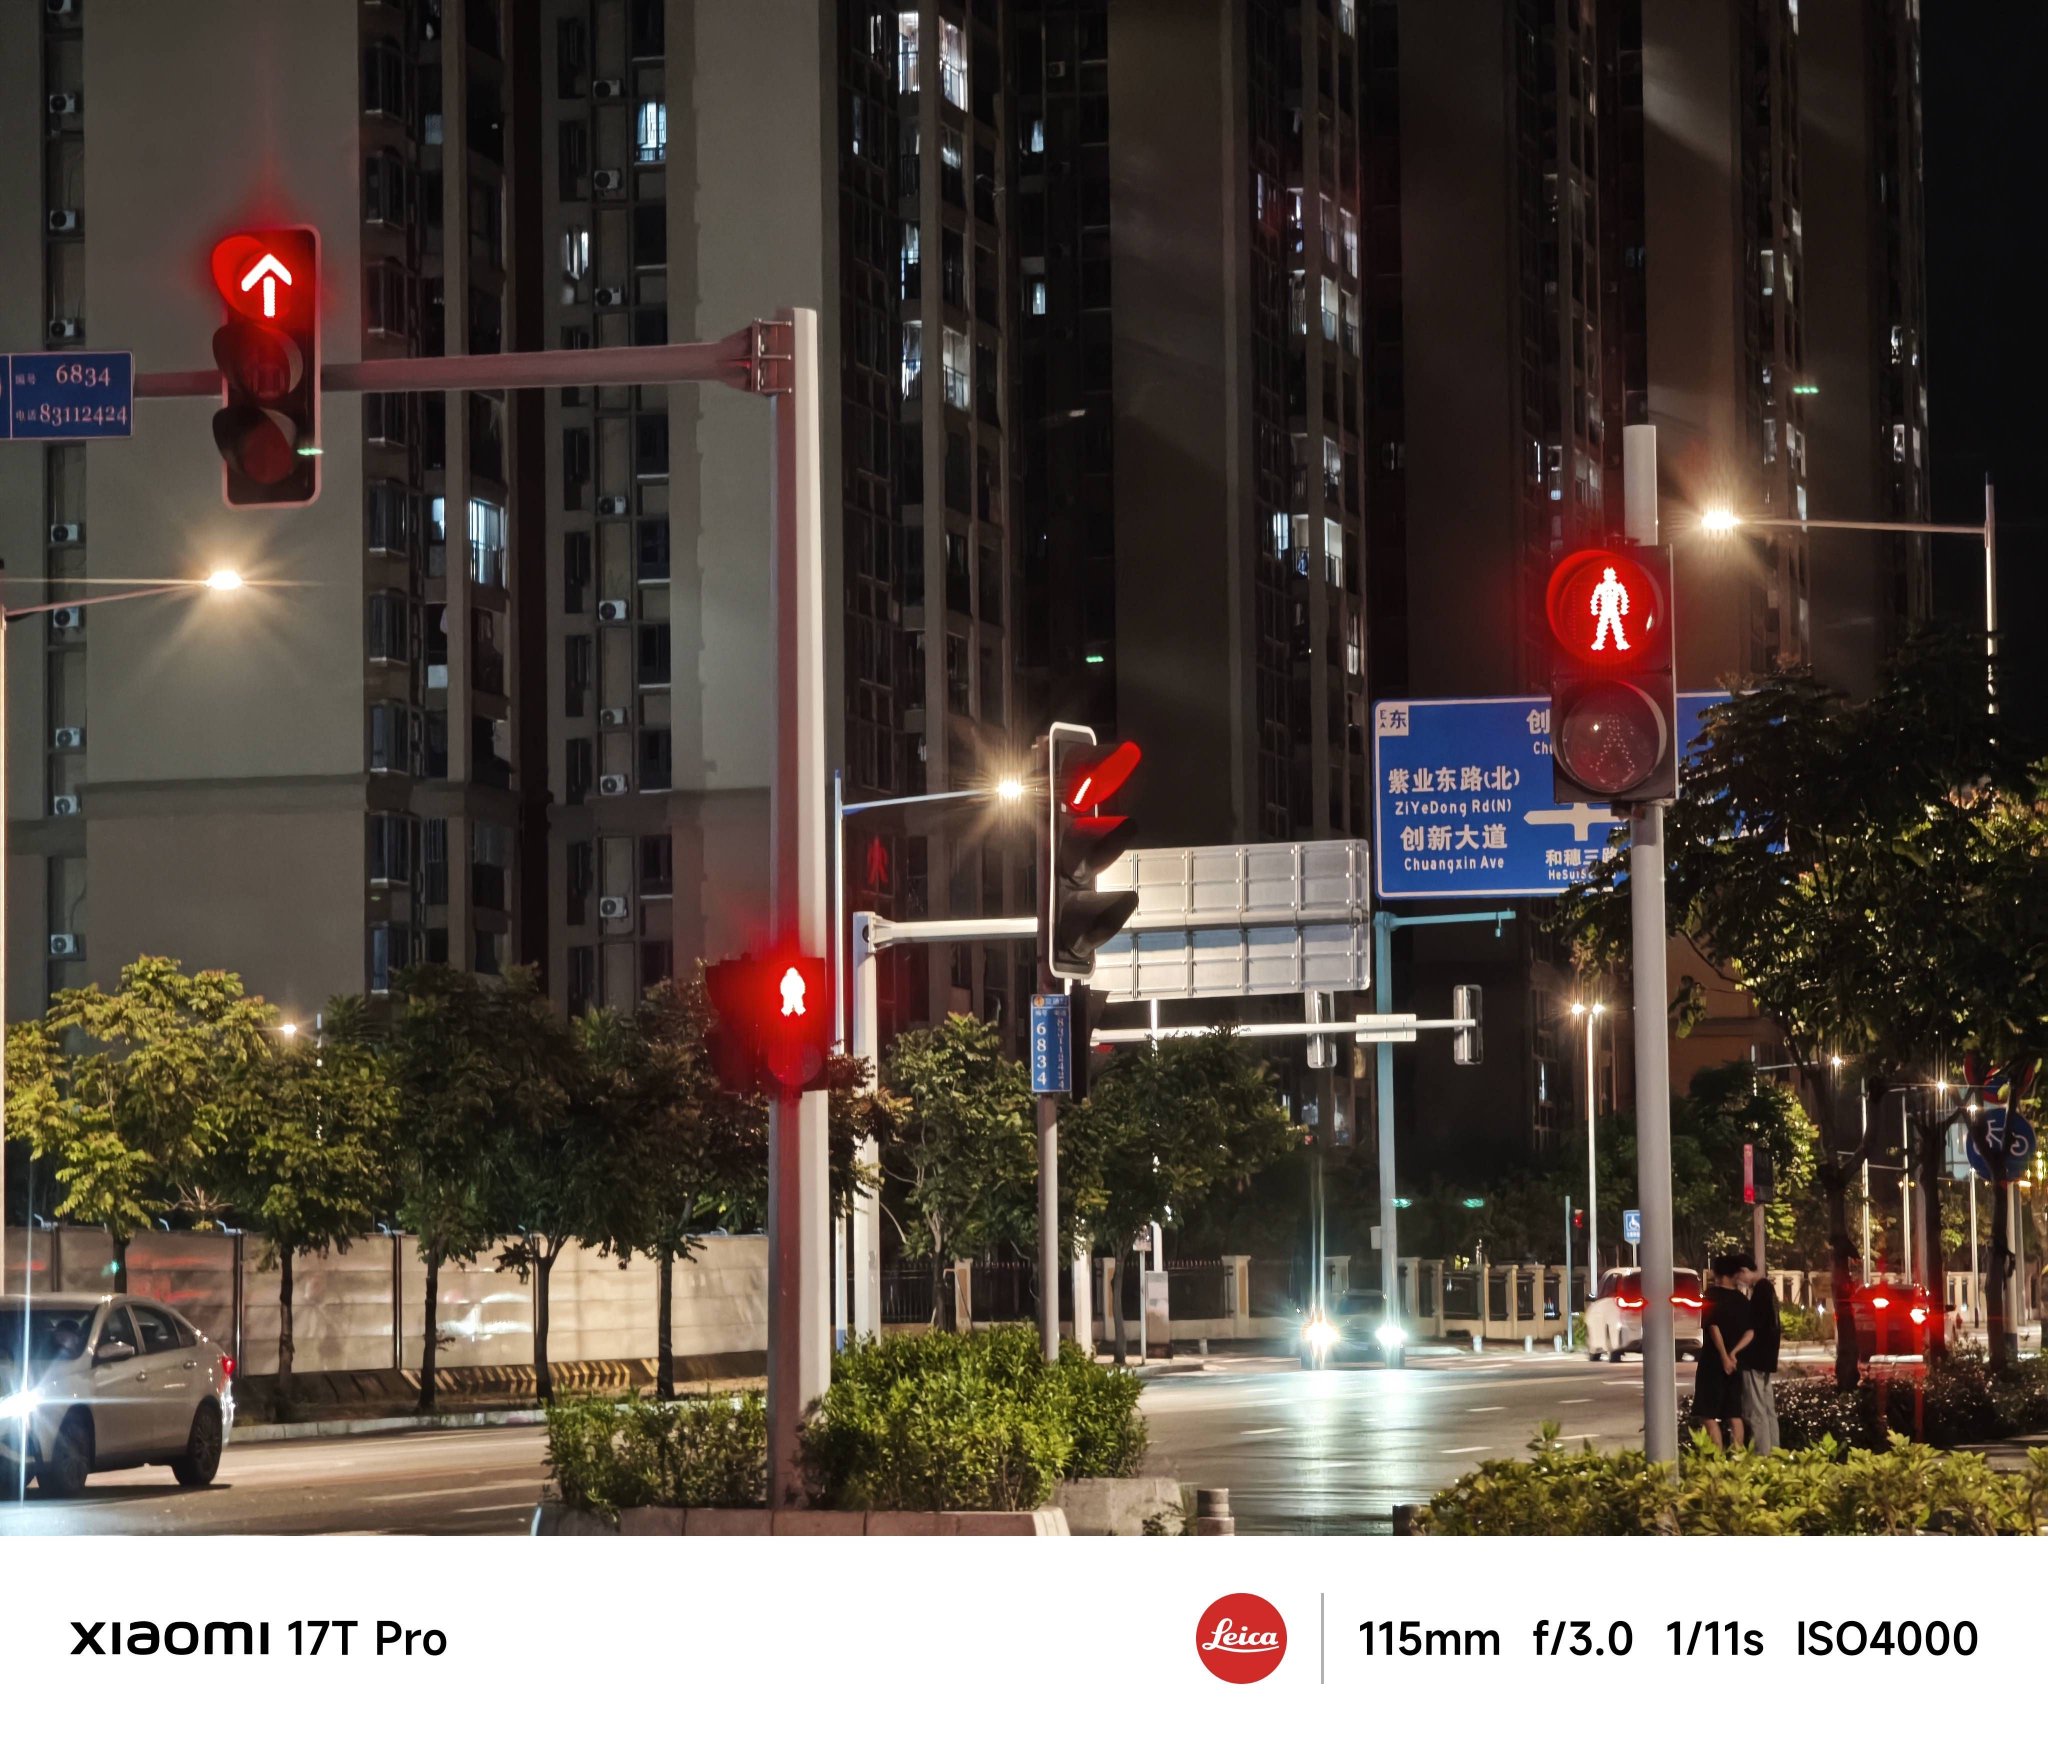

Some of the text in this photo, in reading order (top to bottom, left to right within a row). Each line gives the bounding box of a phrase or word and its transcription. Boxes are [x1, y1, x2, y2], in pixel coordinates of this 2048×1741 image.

[56, 363, 111, 388] 6834
[40, 402, 127, 428] 83112424
[1389, 709, 1407, 729] 东
[1395, 798, 1512, 818] ZiYeDong Rd(N)
[1400, 823, 1508, 852] 创新大道
[1404, 855, 1505, 874] Chuangxin Ave
